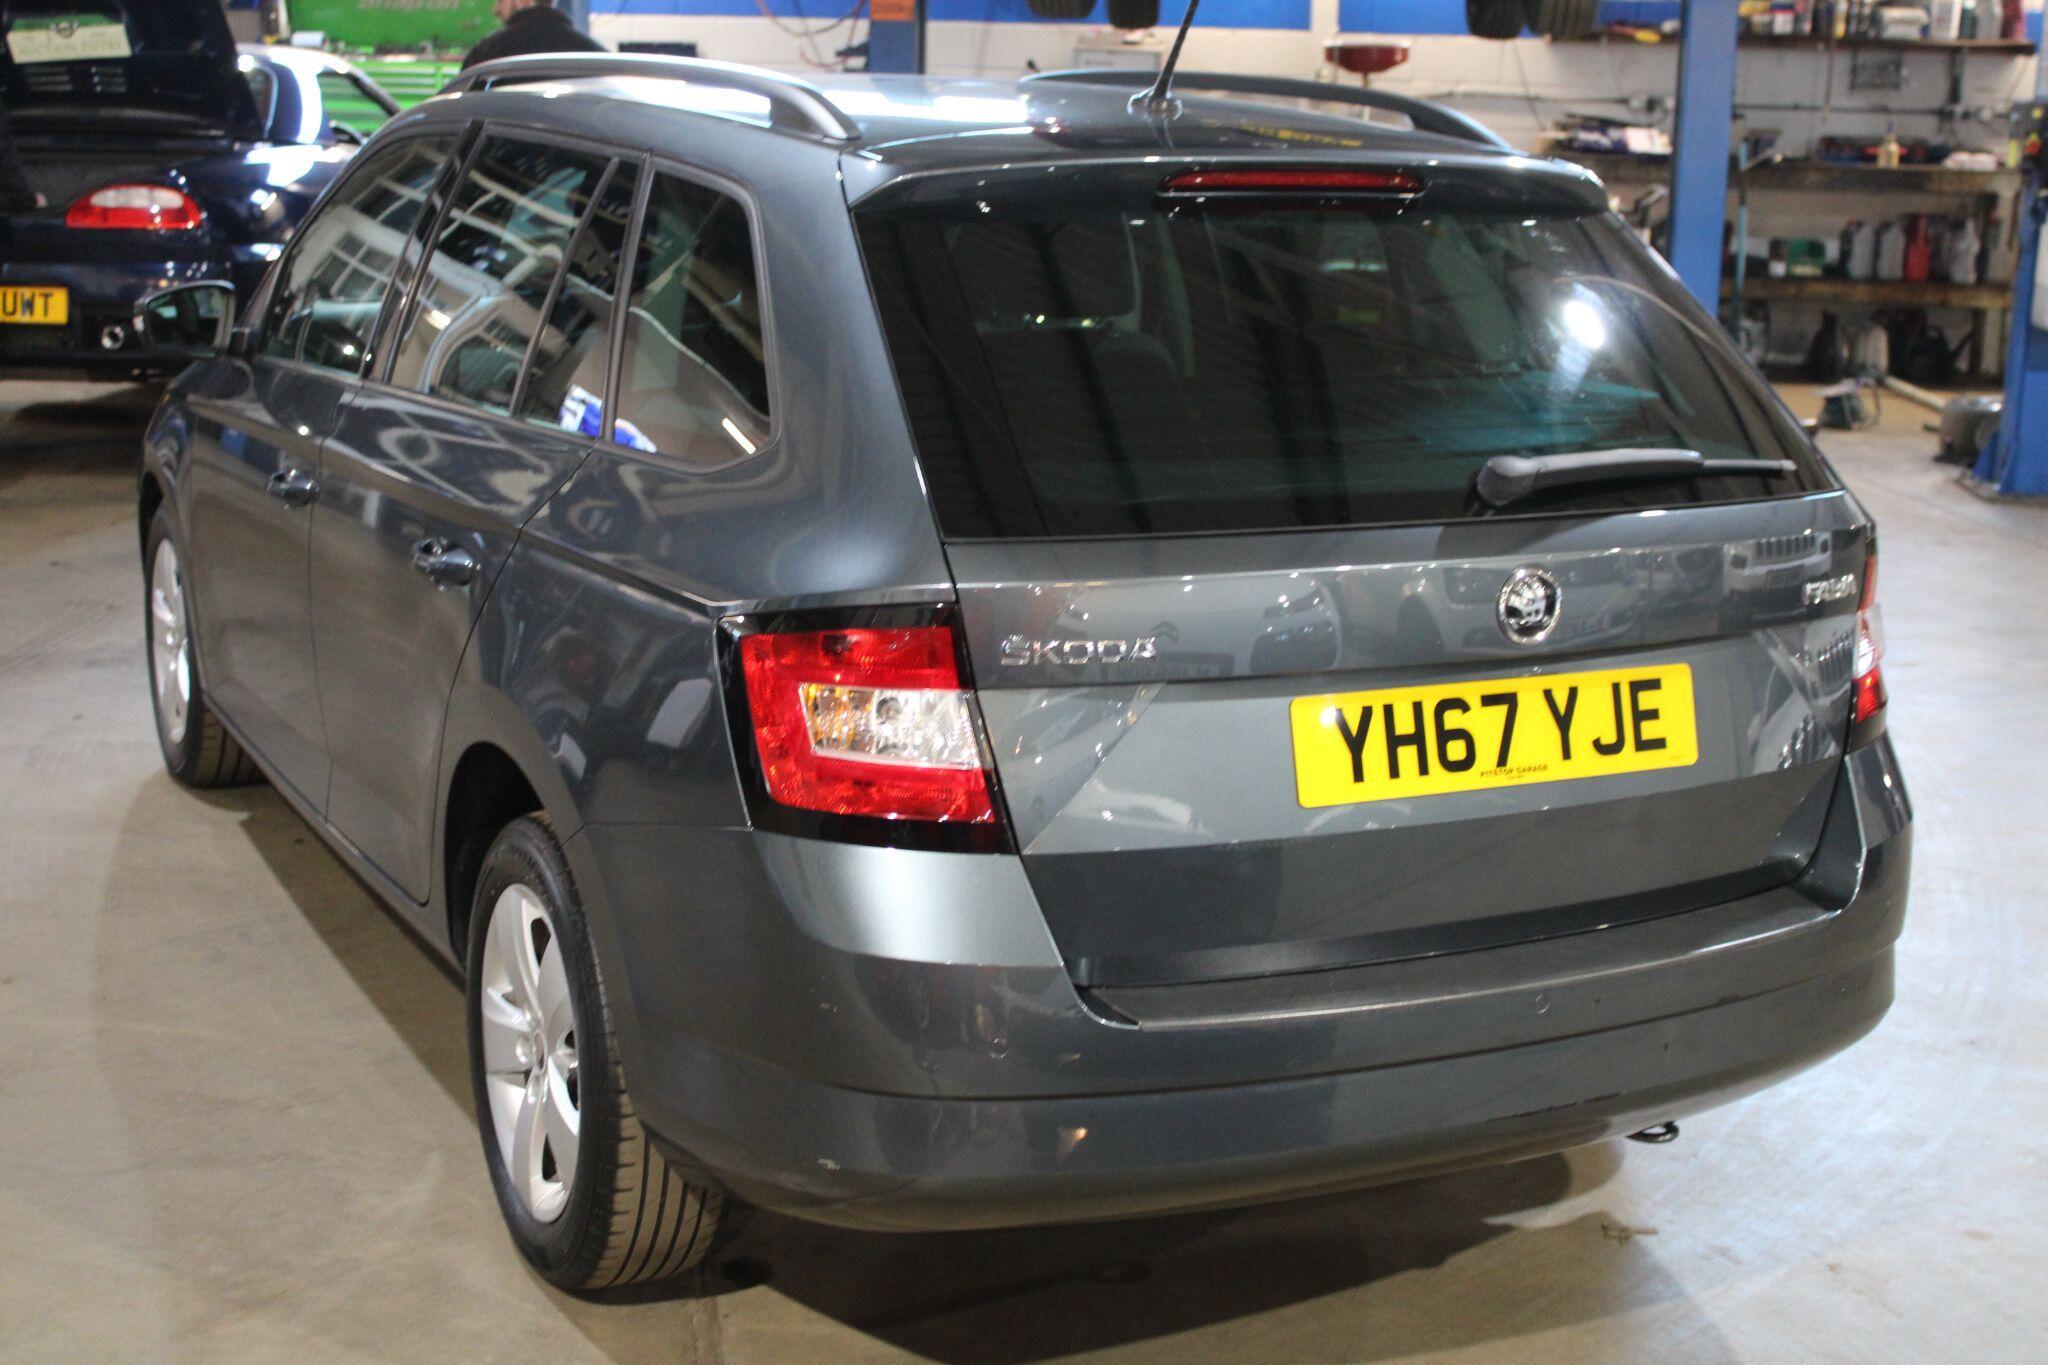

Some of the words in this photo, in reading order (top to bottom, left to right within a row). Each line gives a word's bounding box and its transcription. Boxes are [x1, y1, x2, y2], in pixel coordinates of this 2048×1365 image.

[2, 290, 54, 318] UWT
[1336, 693, 1518, 783] YH67
[1544, 678, 1667, 761] YJE
